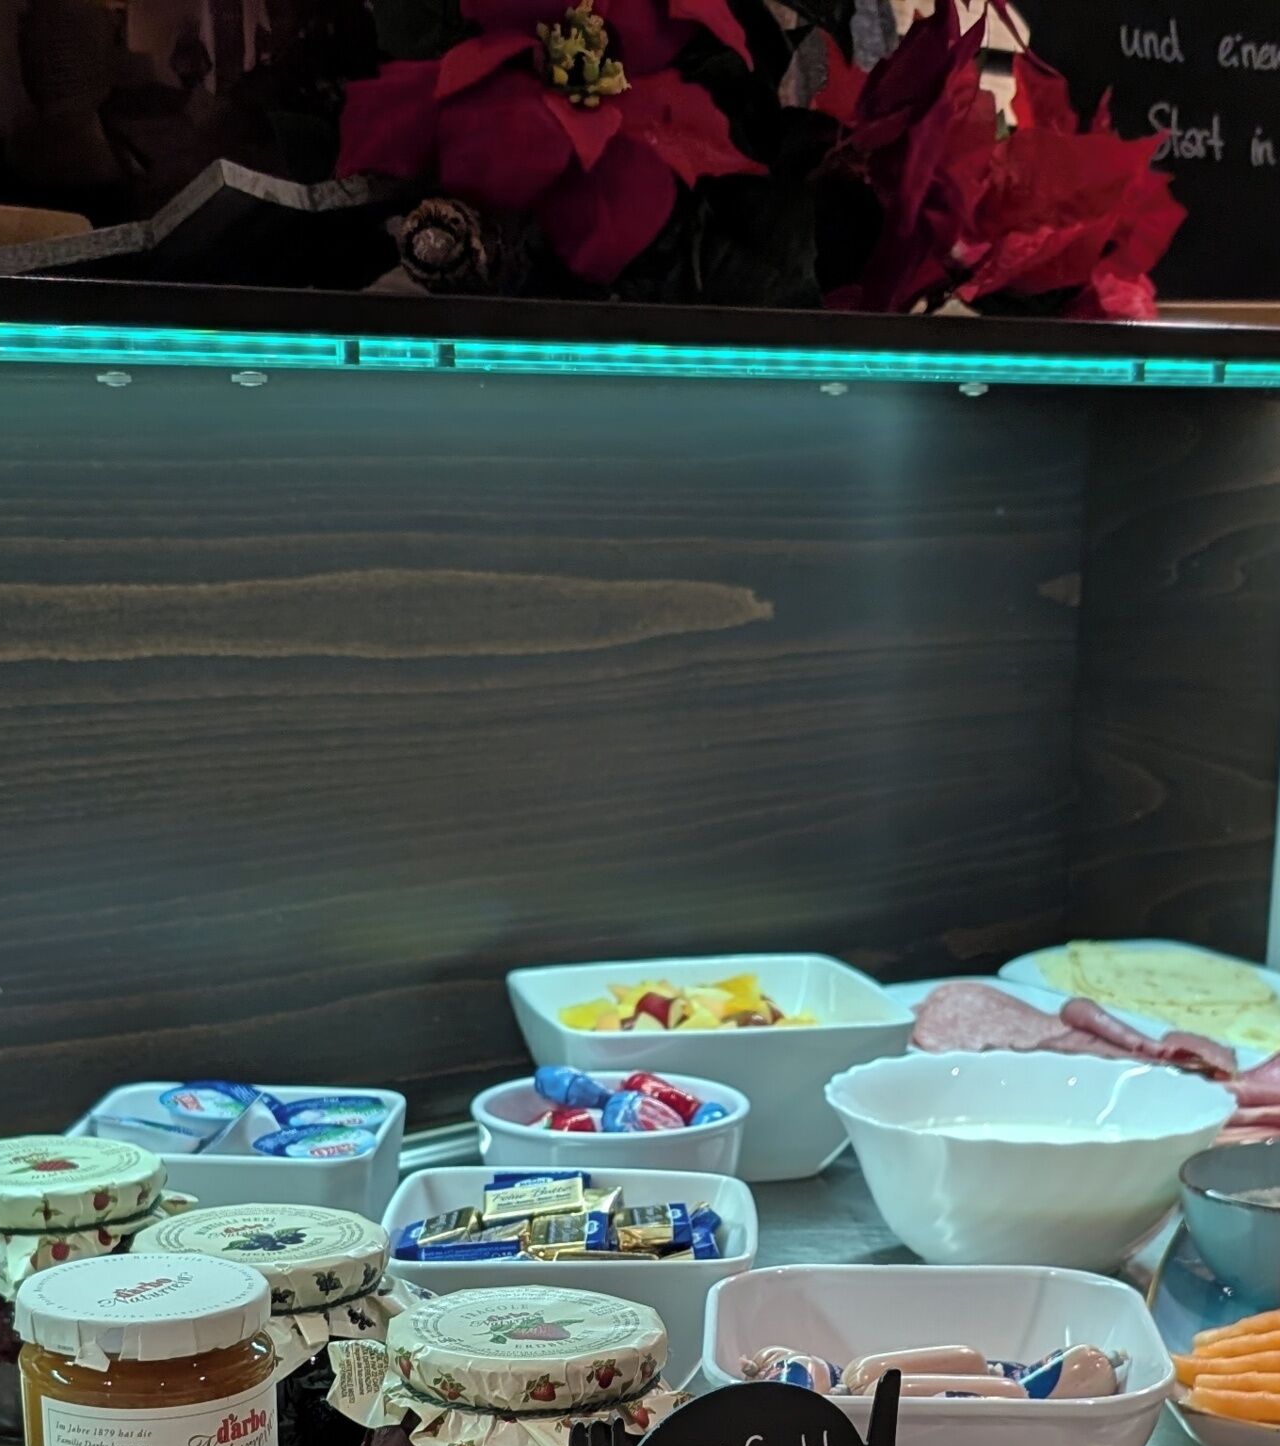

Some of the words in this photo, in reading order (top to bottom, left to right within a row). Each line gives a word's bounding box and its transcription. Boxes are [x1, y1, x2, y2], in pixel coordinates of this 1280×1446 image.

[1120, 18, 1184, 63] und
[1148, 102, 1223, 162] Start
[1251, 126, 1275, 166] in
[56, 1421, 65, 1430] Im
[68, 1424, 89, 1434] Jahre
[118, 1429, 134, 1438] hat
[137, 1429, 152, 1438] die
[57, 1435, 82, 1446] Familie
